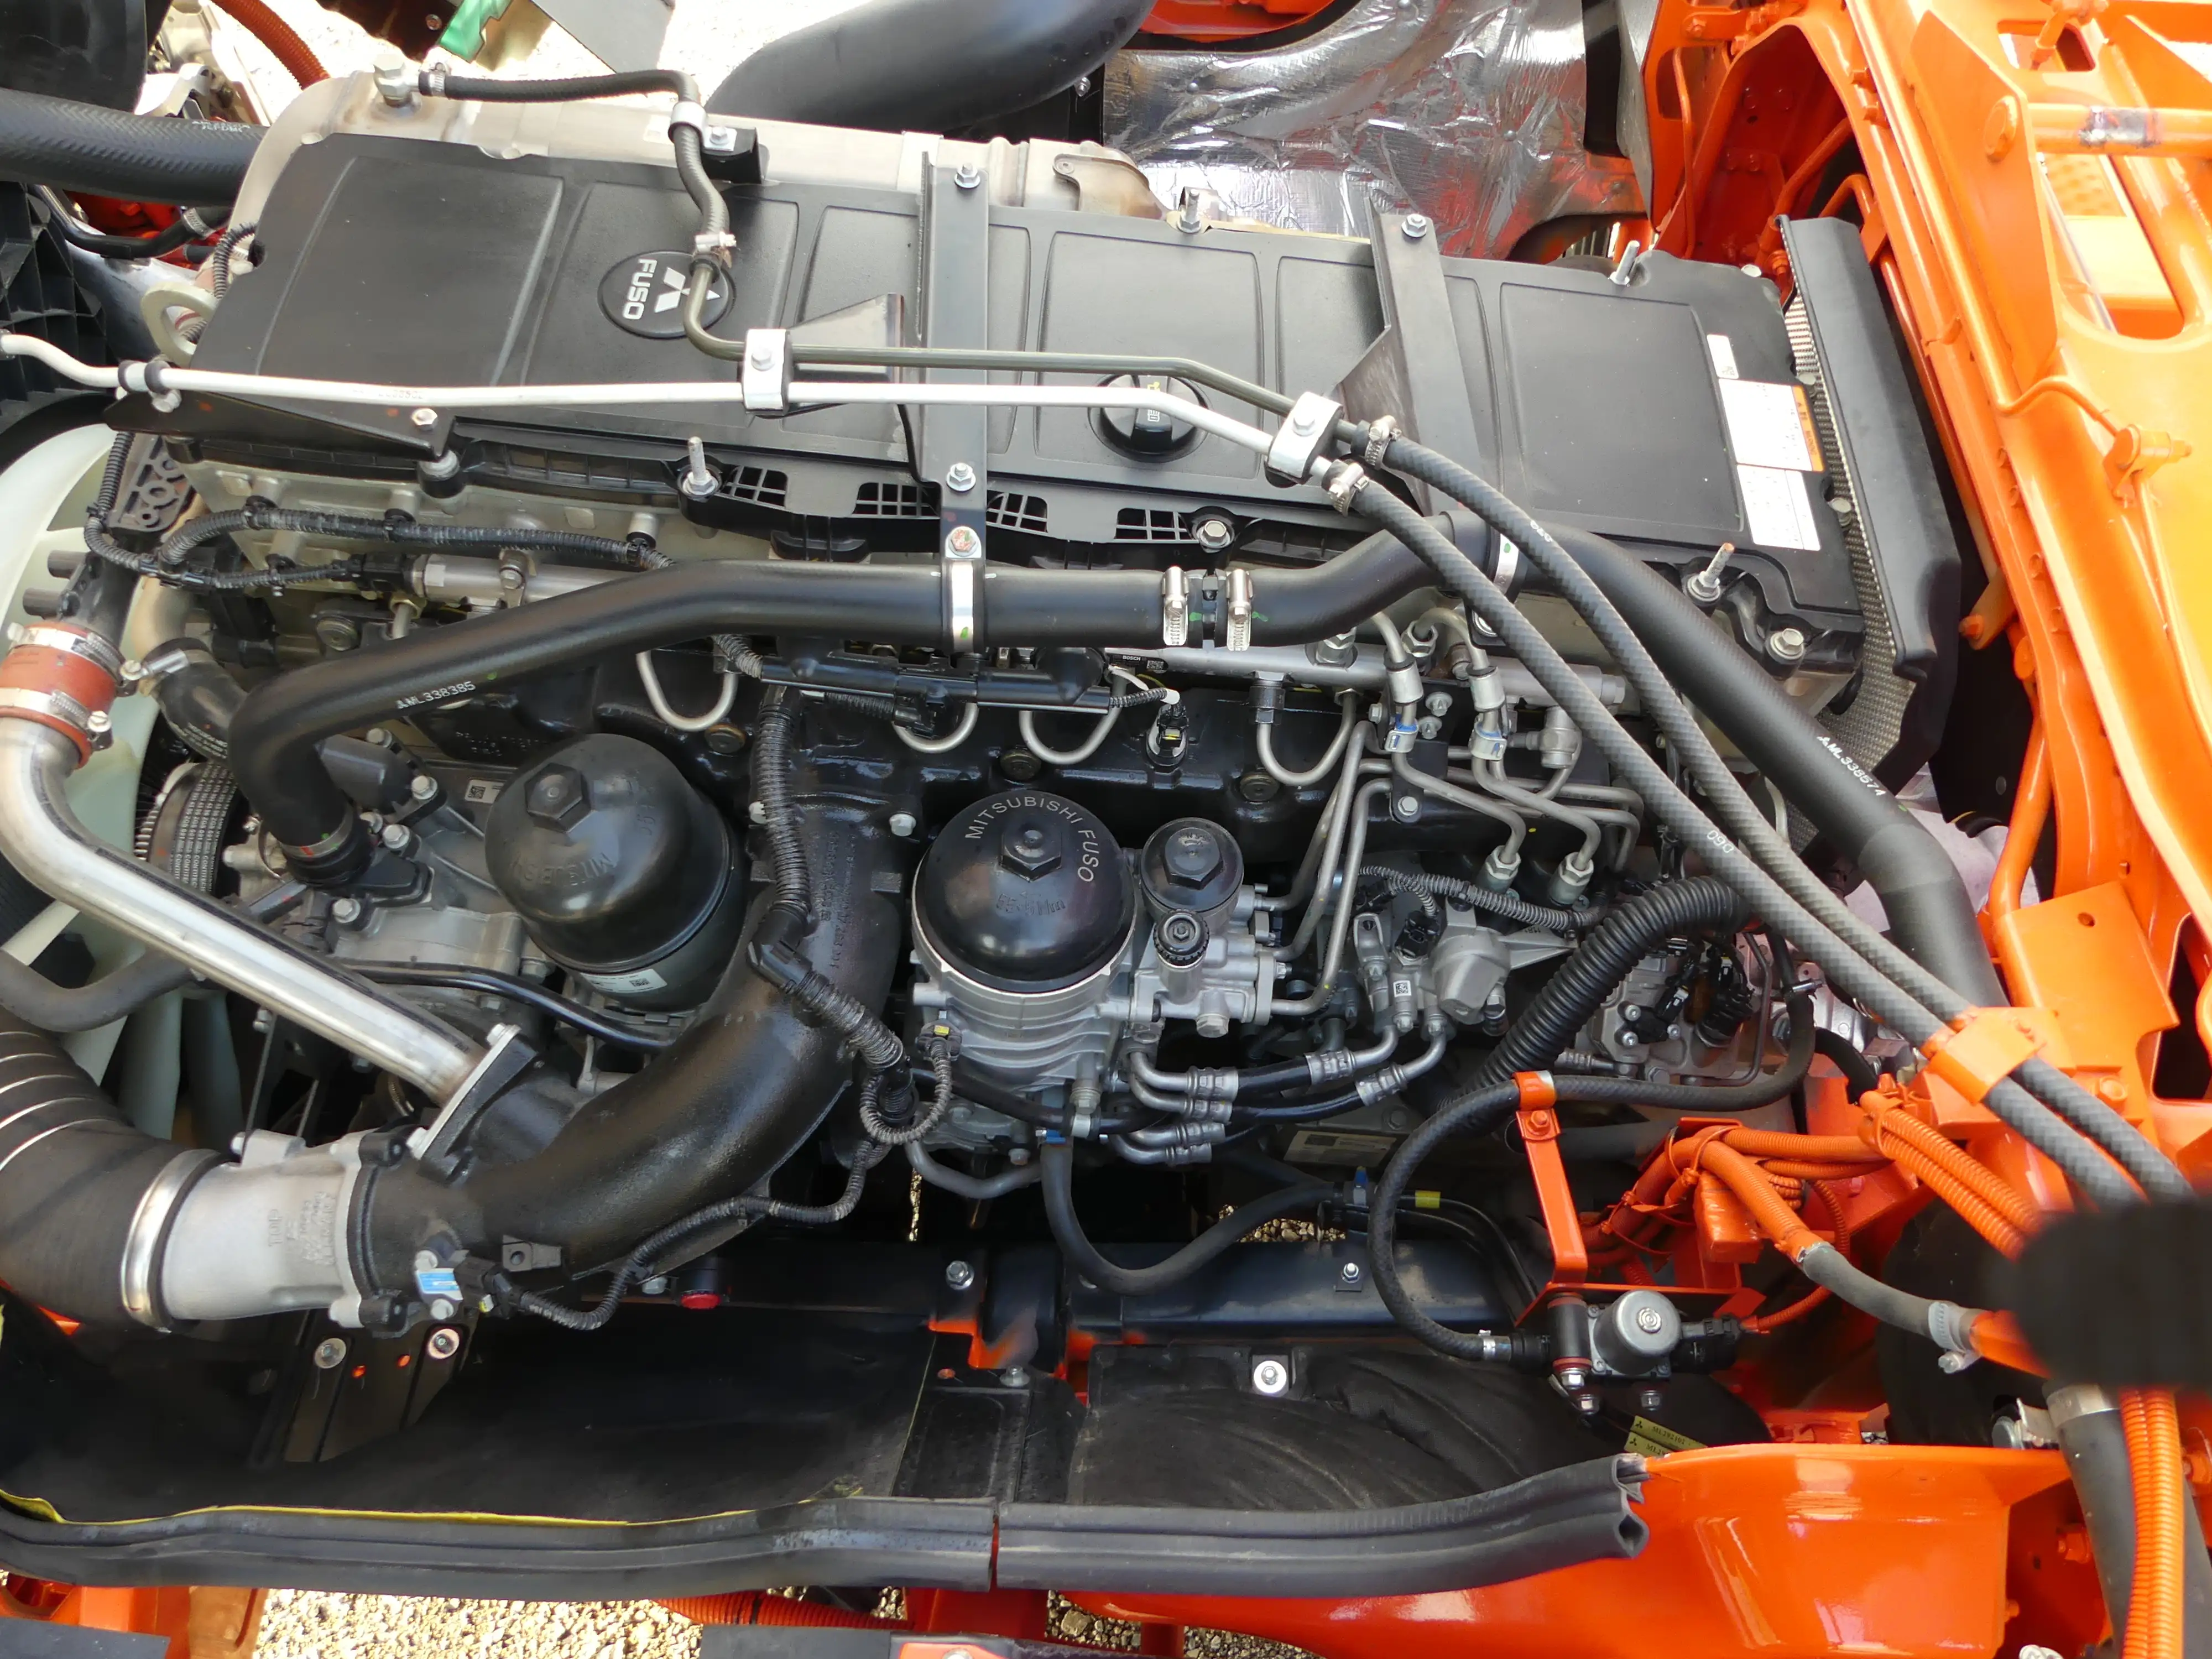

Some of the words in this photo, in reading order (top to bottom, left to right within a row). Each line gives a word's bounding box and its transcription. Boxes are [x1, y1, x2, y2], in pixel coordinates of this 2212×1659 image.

[623, 259, 658, 320] FUSO
[964, 796, 1083, 839] MITSUBISHI
[1077, 830, 1099, 882] FUSO
[268, 1209, 283, 1246] TOP
